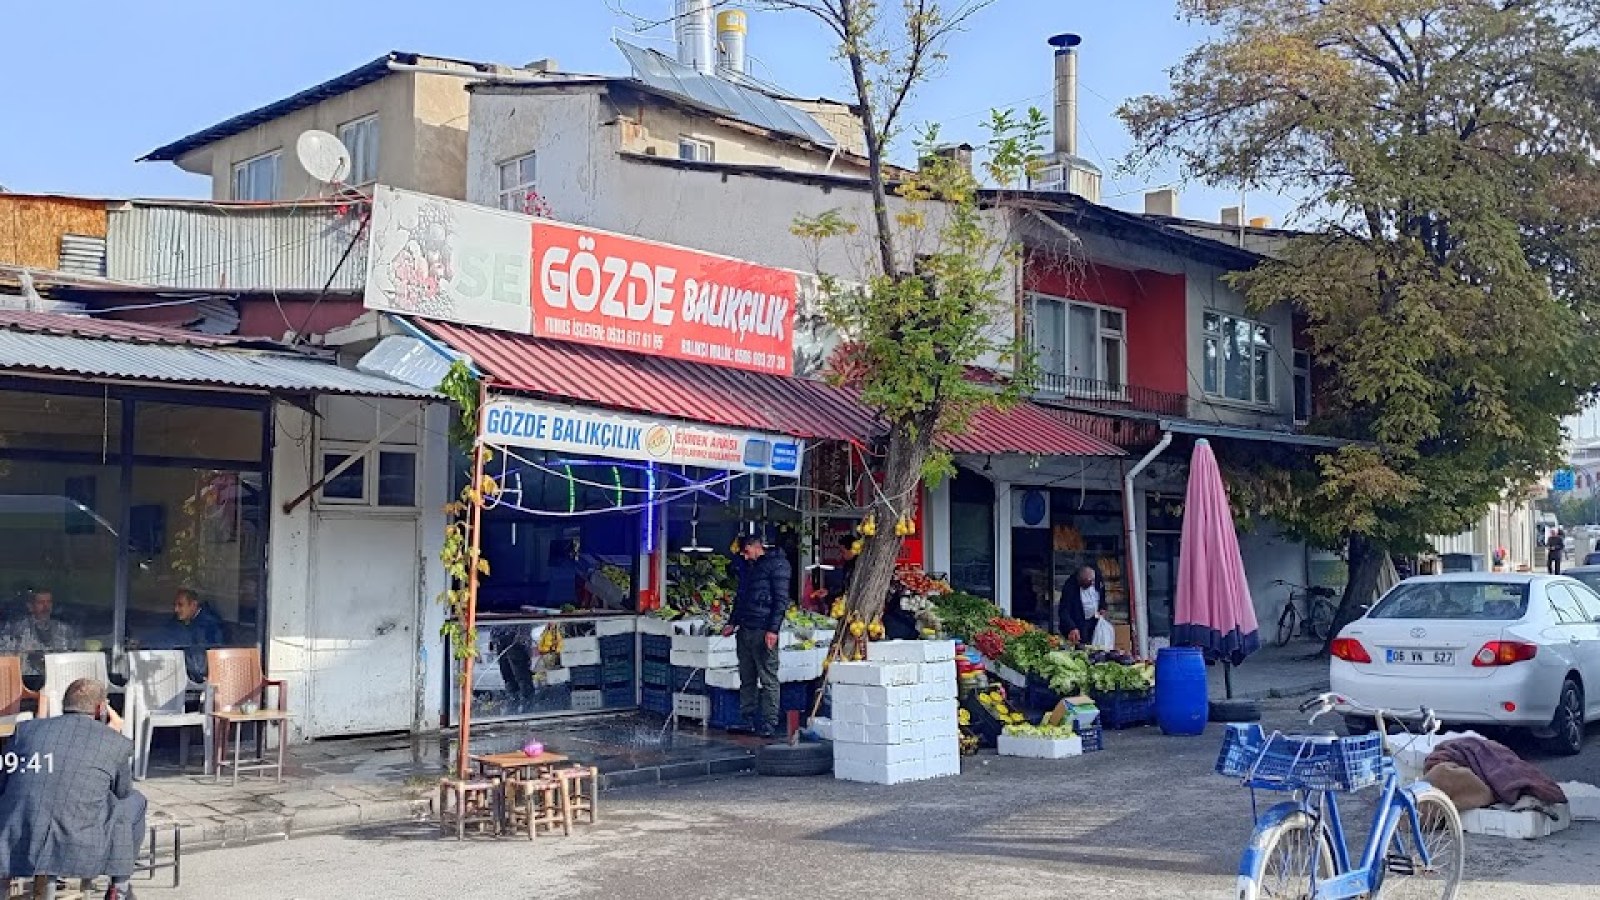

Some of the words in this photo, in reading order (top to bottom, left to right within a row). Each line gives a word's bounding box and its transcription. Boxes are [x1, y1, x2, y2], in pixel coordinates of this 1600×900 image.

[541, 236, 677, 326] GÖZDE
[682, 278, 788, 342] BALIKÇILIK
[487, 404, 548, 439] GÖZDE
[551, 417, 643, 451] BALIKÇILIK
[675, 431, 708, 447] EKMEK
[711, 435, 738, 451] ARASI
